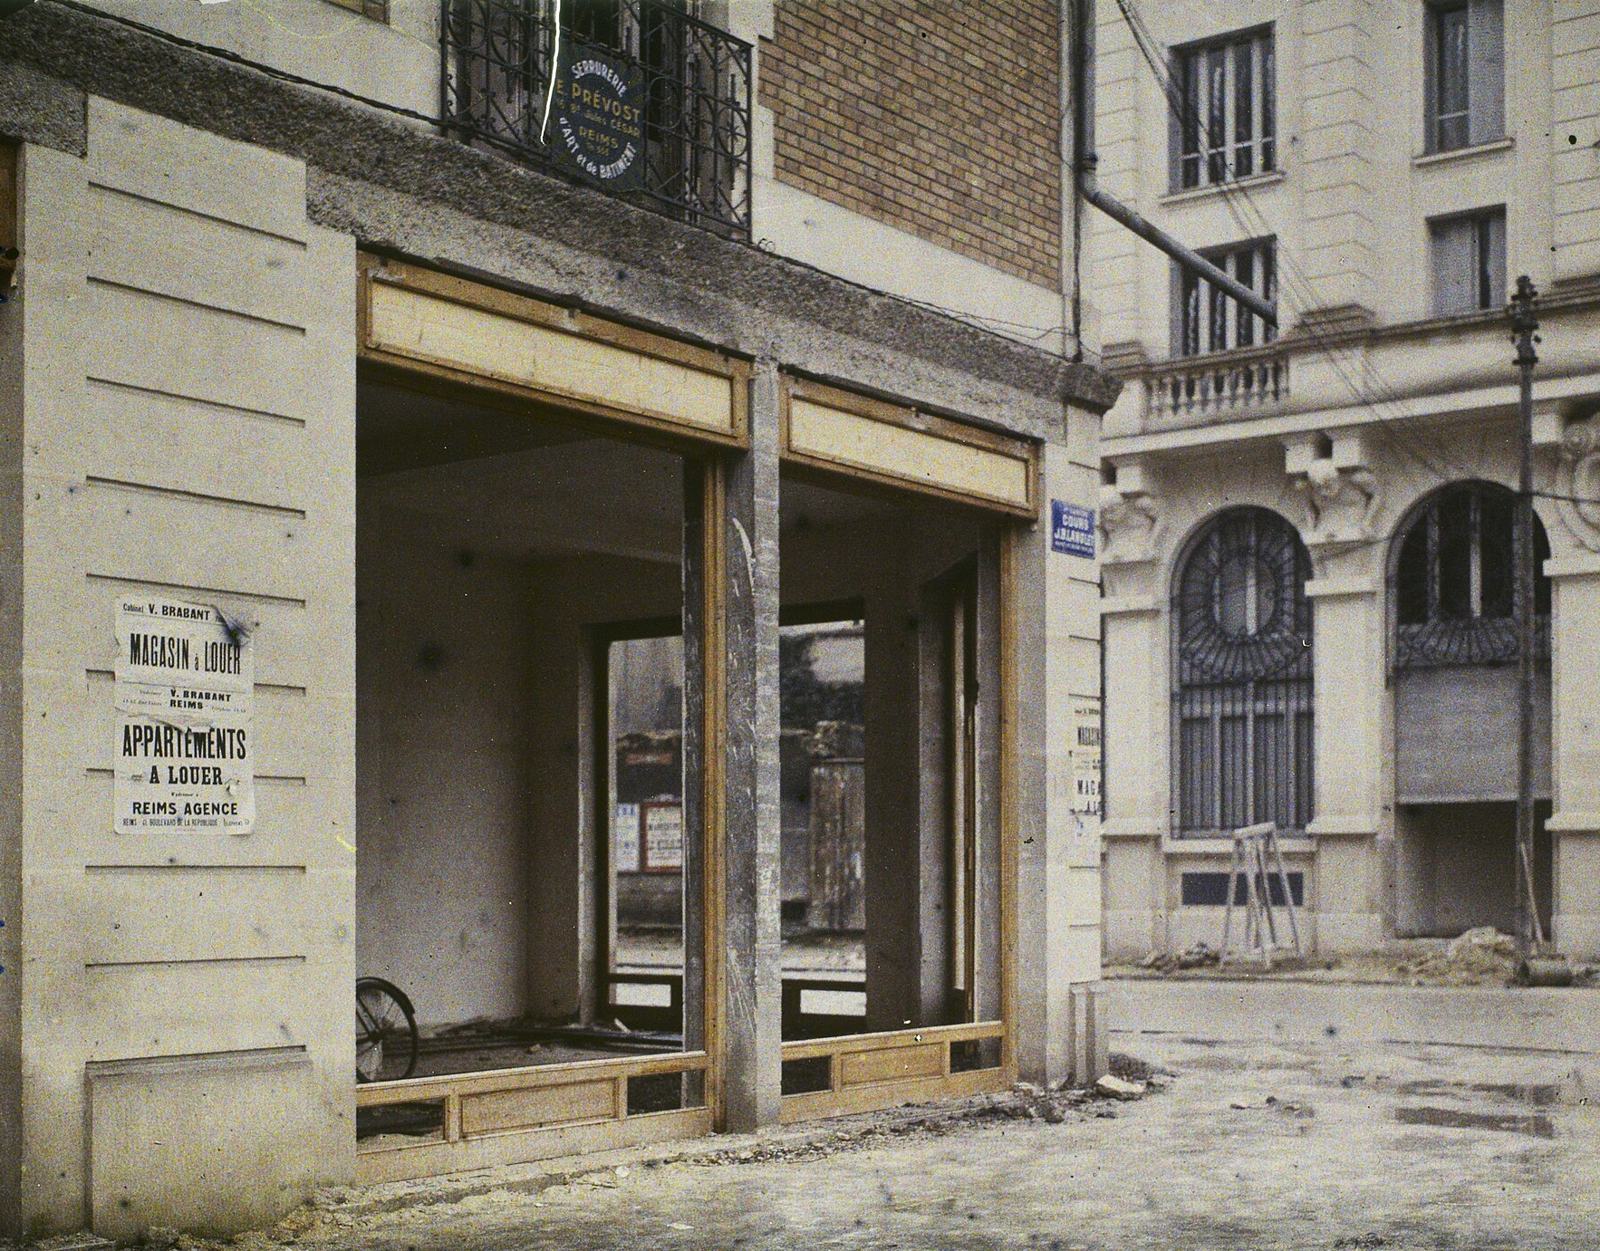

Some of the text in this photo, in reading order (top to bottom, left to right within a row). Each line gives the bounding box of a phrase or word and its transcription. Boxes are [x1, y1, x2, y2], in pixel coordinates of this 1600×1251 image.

[571, 60, 627, 97] SERRURERIE
[572, 83, 640, 123] PRÉVOST
[579, 126, 618, 149] REIMS
[149, 603, 157, 615] V.
[162, 605, 210, 620] BRABANT
[130, 633, 189, 669] MAGASIN
[204, 641, 240, 675] LOUER
[170, 688, 180, 698] V.
[183, 690, 231, 702] BRABANT
[170, 699, 203, 709] REIMS
[122, 724, 246, 760] APPARTEMENTS
[149, 765, 223, 785] A LOUER
[133, 802, 238, 816] REIMS AGENCE
